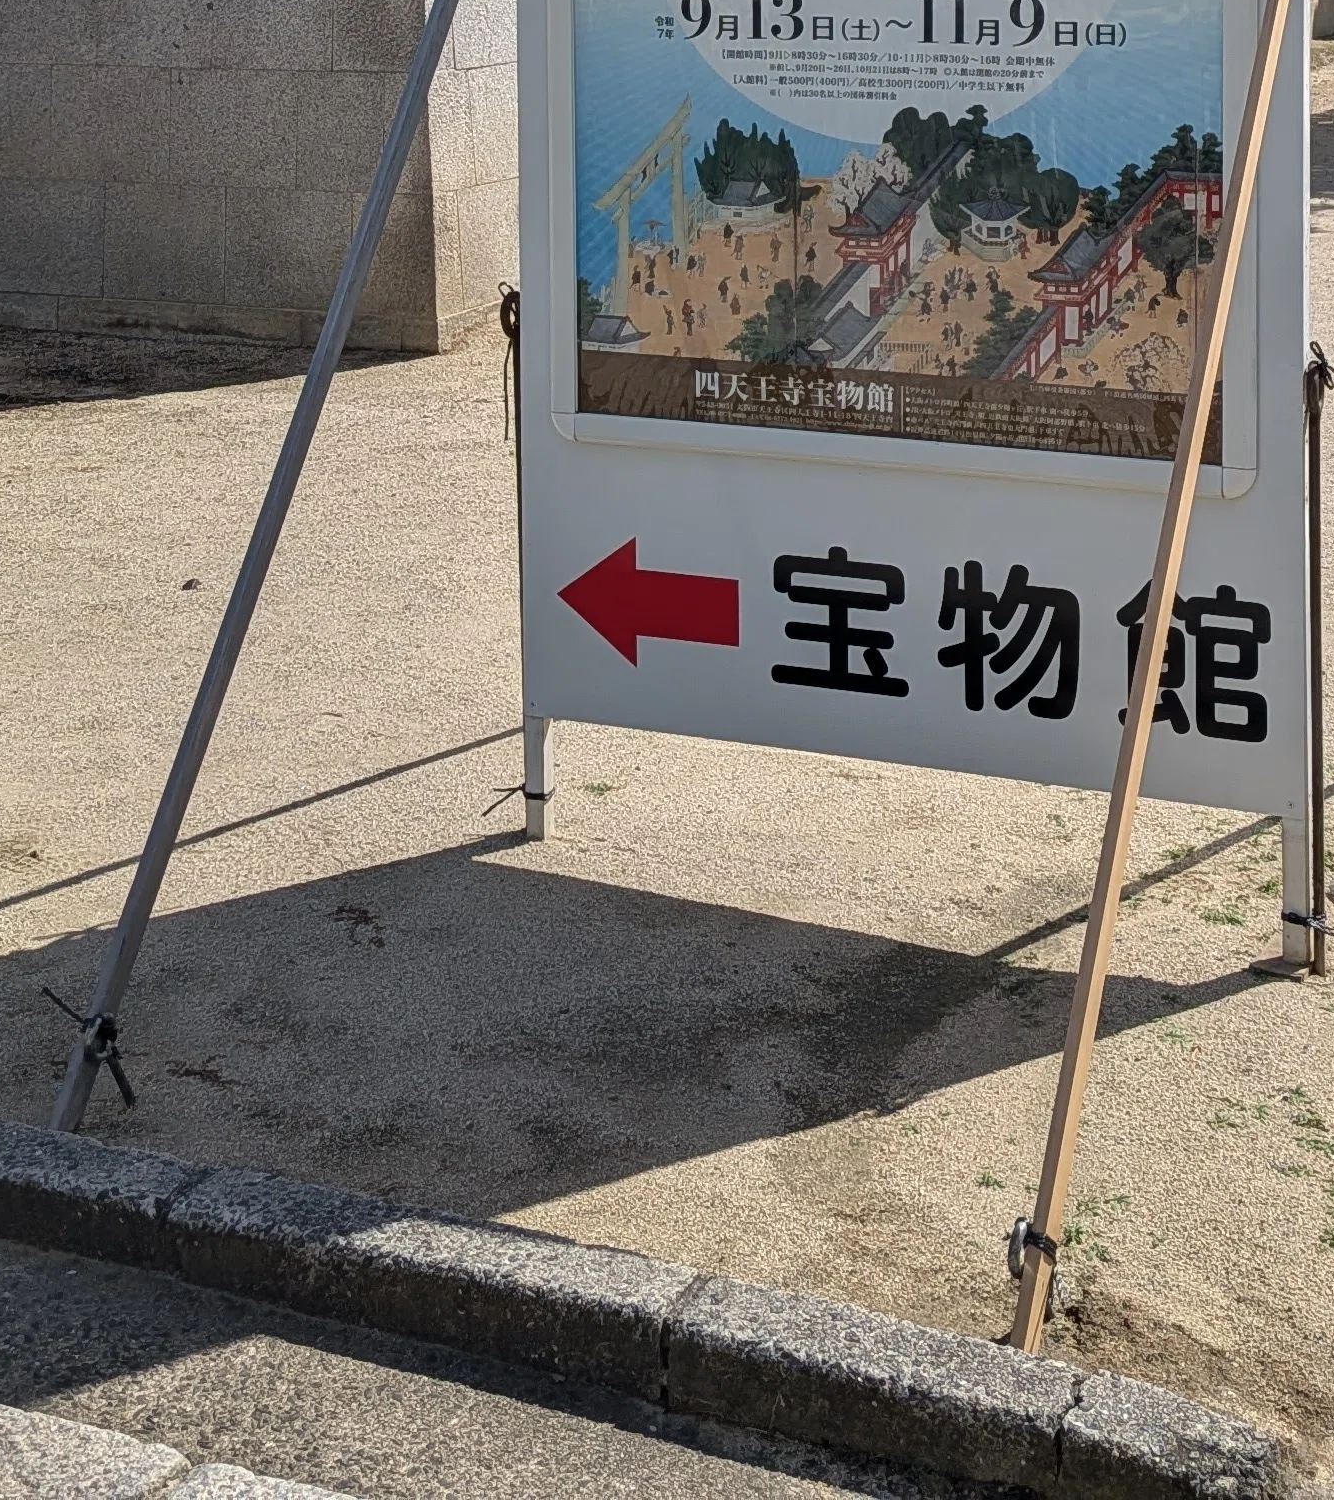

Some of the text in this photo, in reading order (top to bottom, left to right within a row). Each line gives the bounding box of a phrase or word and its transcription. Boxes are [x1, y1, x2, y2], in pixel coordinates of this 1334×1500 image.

[1006, 55, 1055, 67] 会期中無休
[694, 369, 895, 412] 四天王寺宝物館
[771, 545, 1273, 743] 宝物館
